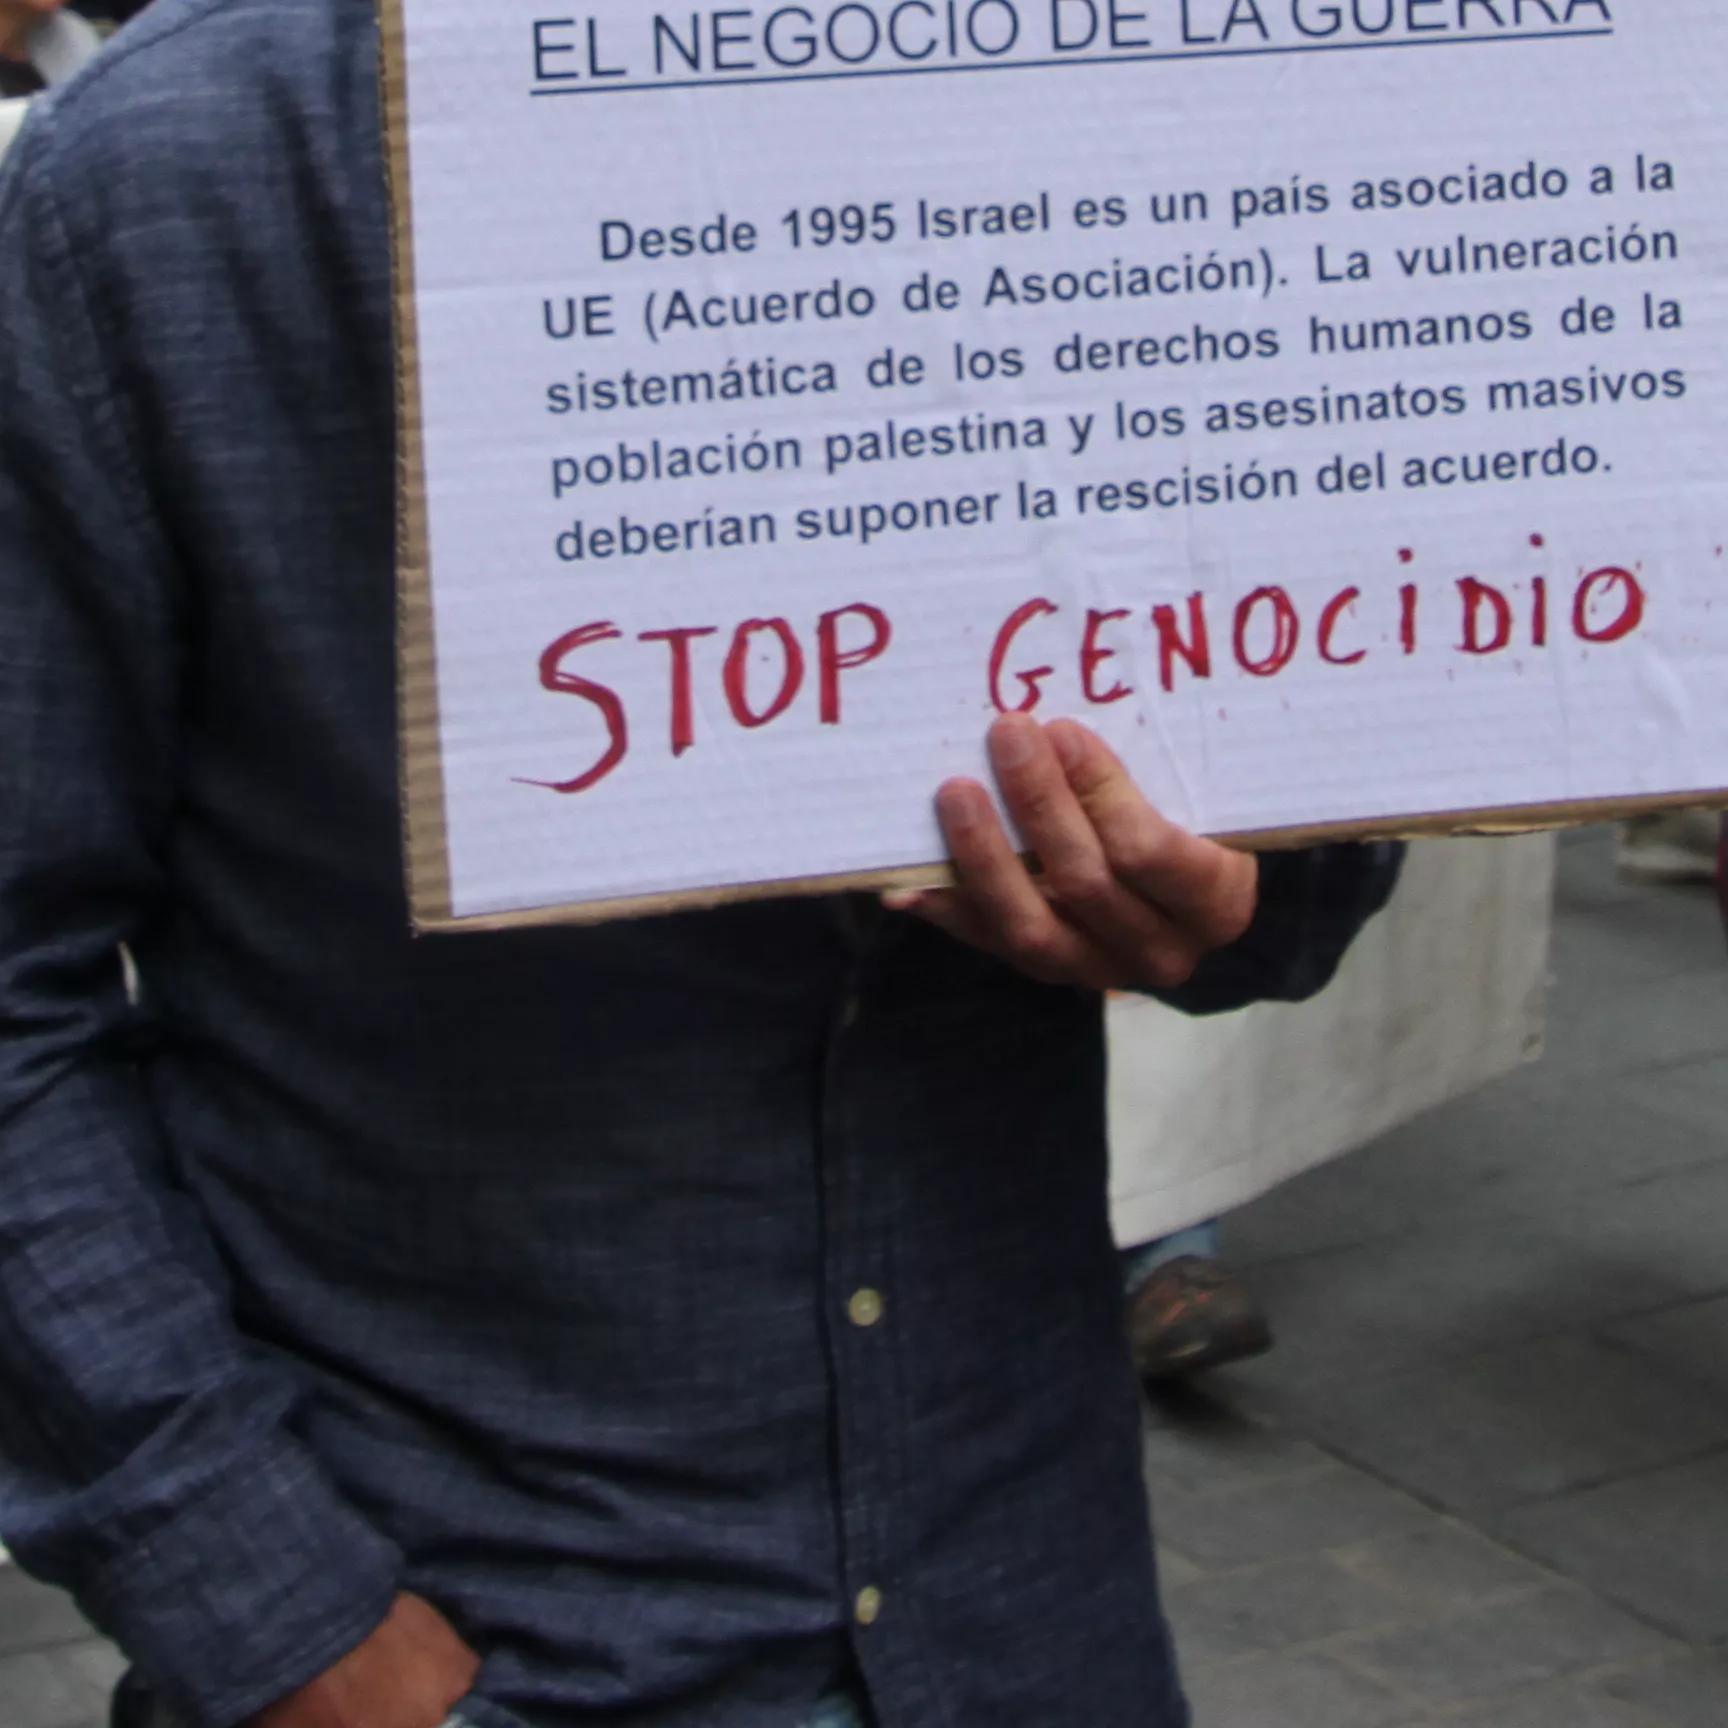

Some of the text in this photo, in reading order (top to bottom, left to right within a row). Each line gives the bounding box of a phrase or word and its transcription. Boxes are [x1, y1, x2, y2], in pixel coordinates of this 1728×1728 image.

[532, 17, 628, 82] EL
[599, 153, 1674, 262] Desde 1995 Israel es un país asociado a la
[542, 222, 1678, 343] UE (Acuerdo de Asociación). La vulneración
[546, 291, 1683, 415] sistemática de los derechos humanos de la
[551, 365, 1687, 499] población palestina y los asesinatos masivos
[555, 436, 1612, 562] deberían suponer la rescisión del acuerdo.
[510, 601, 894, 795] STOP
